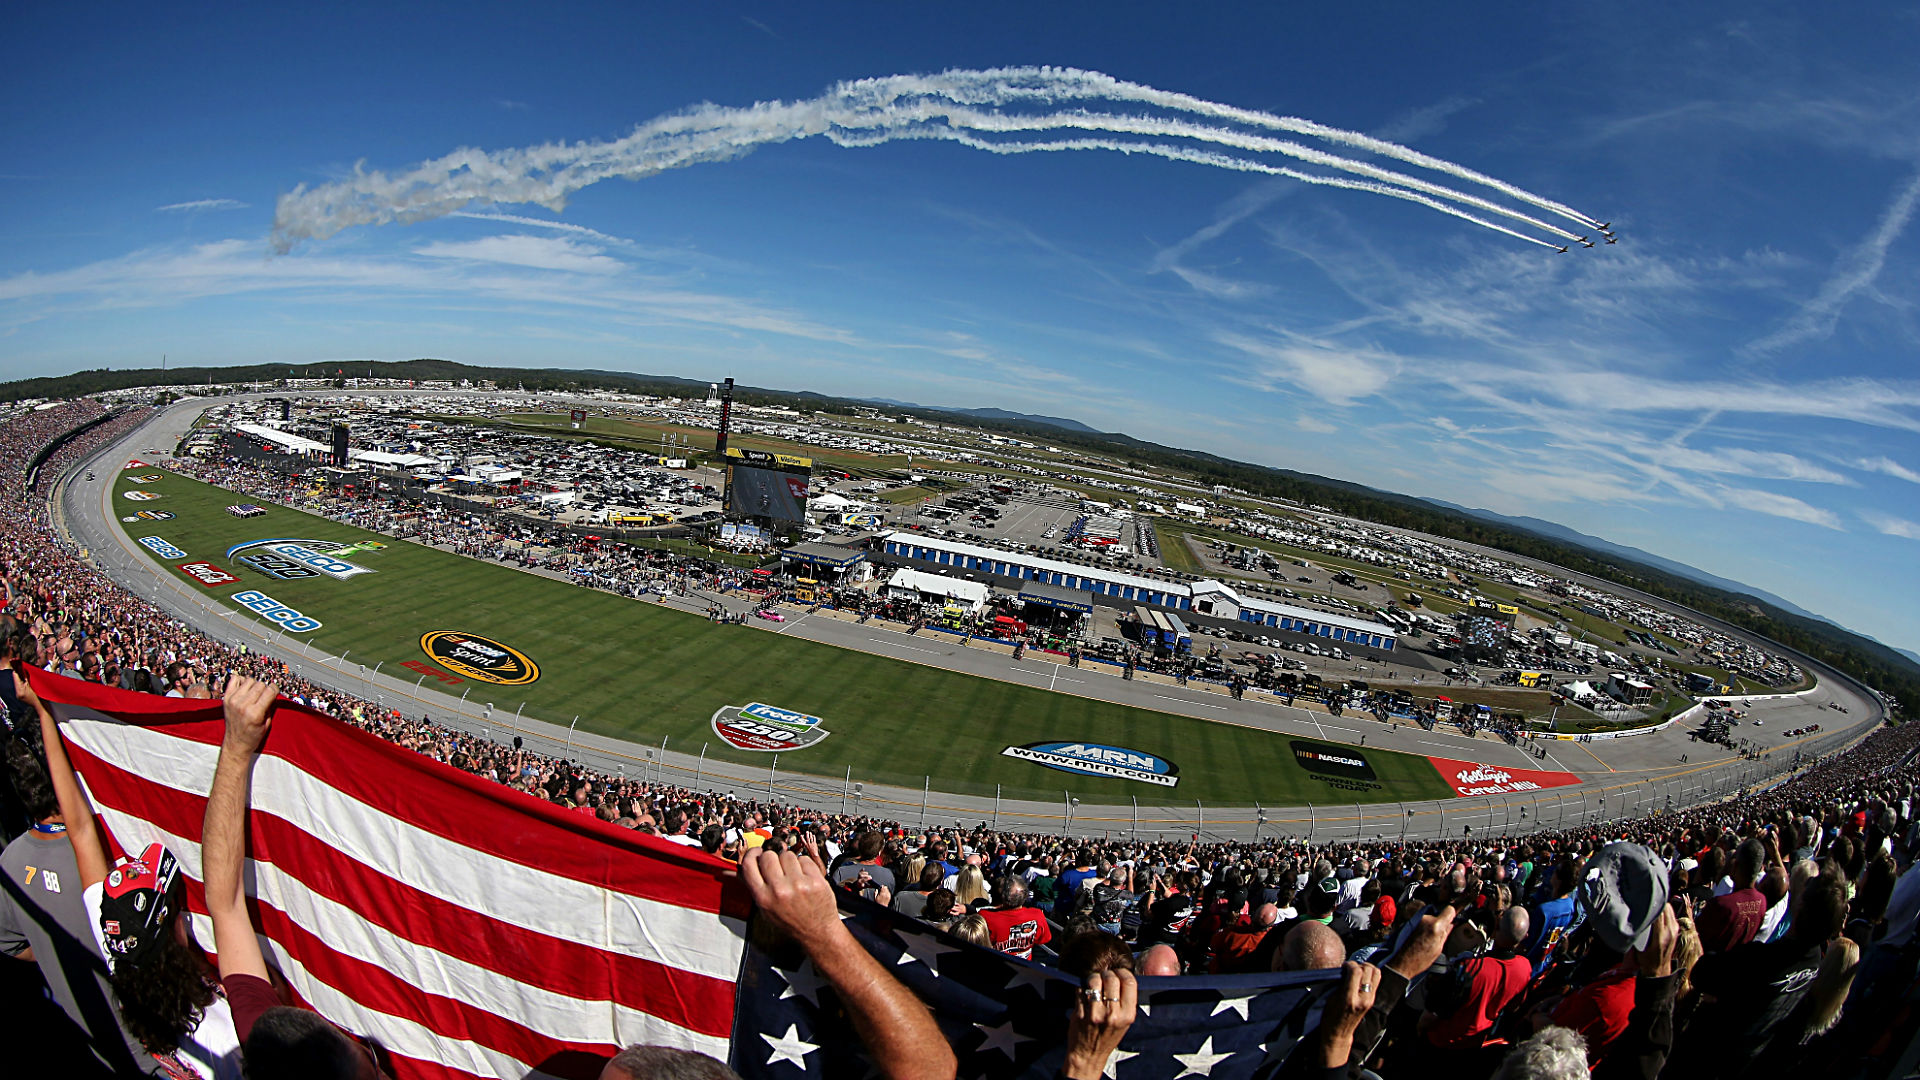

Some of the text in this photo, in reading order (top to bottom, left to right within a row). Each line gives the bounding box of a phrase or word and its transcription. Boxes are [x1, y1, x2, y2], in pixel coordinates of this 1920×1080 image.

[749, 452, 766, 460] Sprint
[780, 456, 801, 464] Vision
[140, 537, 186, 558] GEICO
[245, 554, 321, 579] 500
[276, 545, 353, 573] GEICO
[1021, 595, 1052, 604] GOODYEAR
[1056, 602, 1088, 611] GOODYEAR
[234, 591, 320, 631] GEICO
[449, 647, 496, 666] Sprint
[751, 706, 809, 725] fred's
[726, 721, 795, 740] 250
[1052, 744, 1154, 768] MRN
[1318, 754, 1363, 767] NASCAR
[1013, 748, 1170, 784] www.mrn.com
[1309, 774, 1382, 790] DOWNLOAD
[1457, 770, 1512, 783] Kellogg's
[1329, 782, 1369, 792] TODAY
[1457, 784, 1506, 796] Cereal
[1509, 781, 1542, 791] Milk
[25, 865, 37, 885] 7
[43, 870, 61, 893] 88
